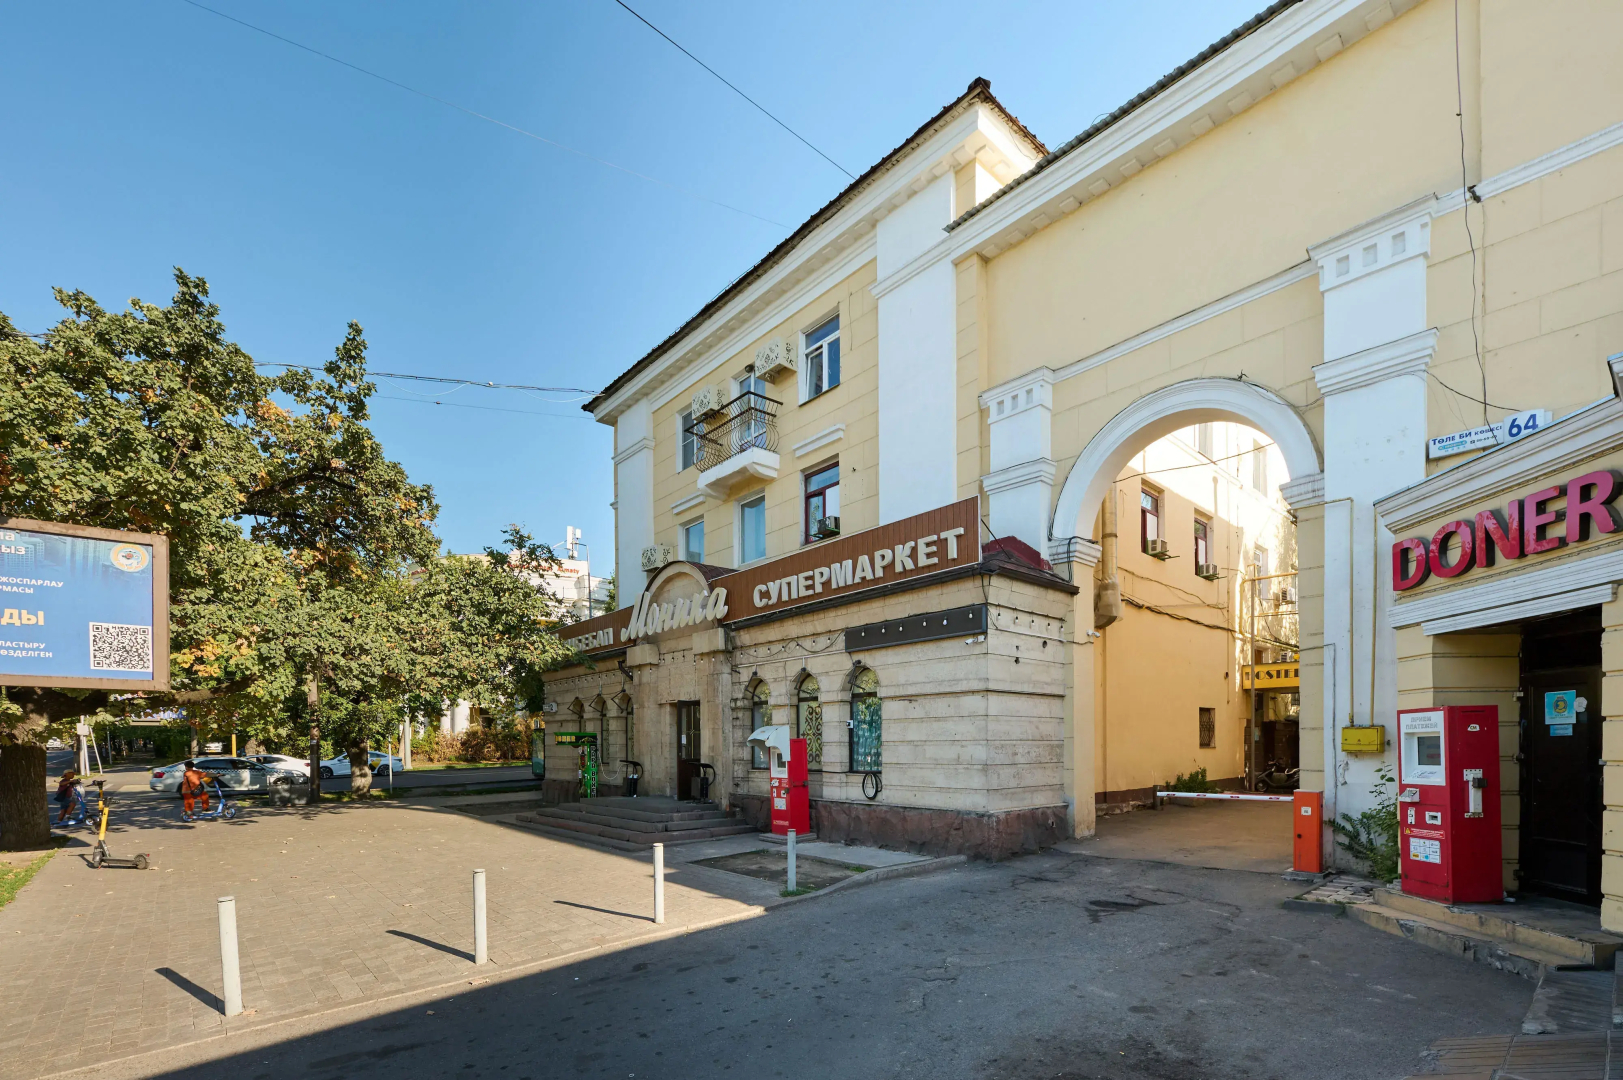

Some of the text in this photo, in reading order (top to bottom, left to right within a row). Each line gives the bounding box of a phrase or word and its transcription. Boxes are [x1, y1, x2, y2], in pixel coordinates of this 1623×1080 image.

[1431, 435, 1456, 446] ТӨЛЕ
[1459, 431, 1472, 440] БИ
[1508, 413, 1539, 438] 64
[1392, 470, 1616, 592] DONER
[753, 527, 964, 608] СУПЕРМАРКЕТ
[621, 585, 729, 643] Моника
